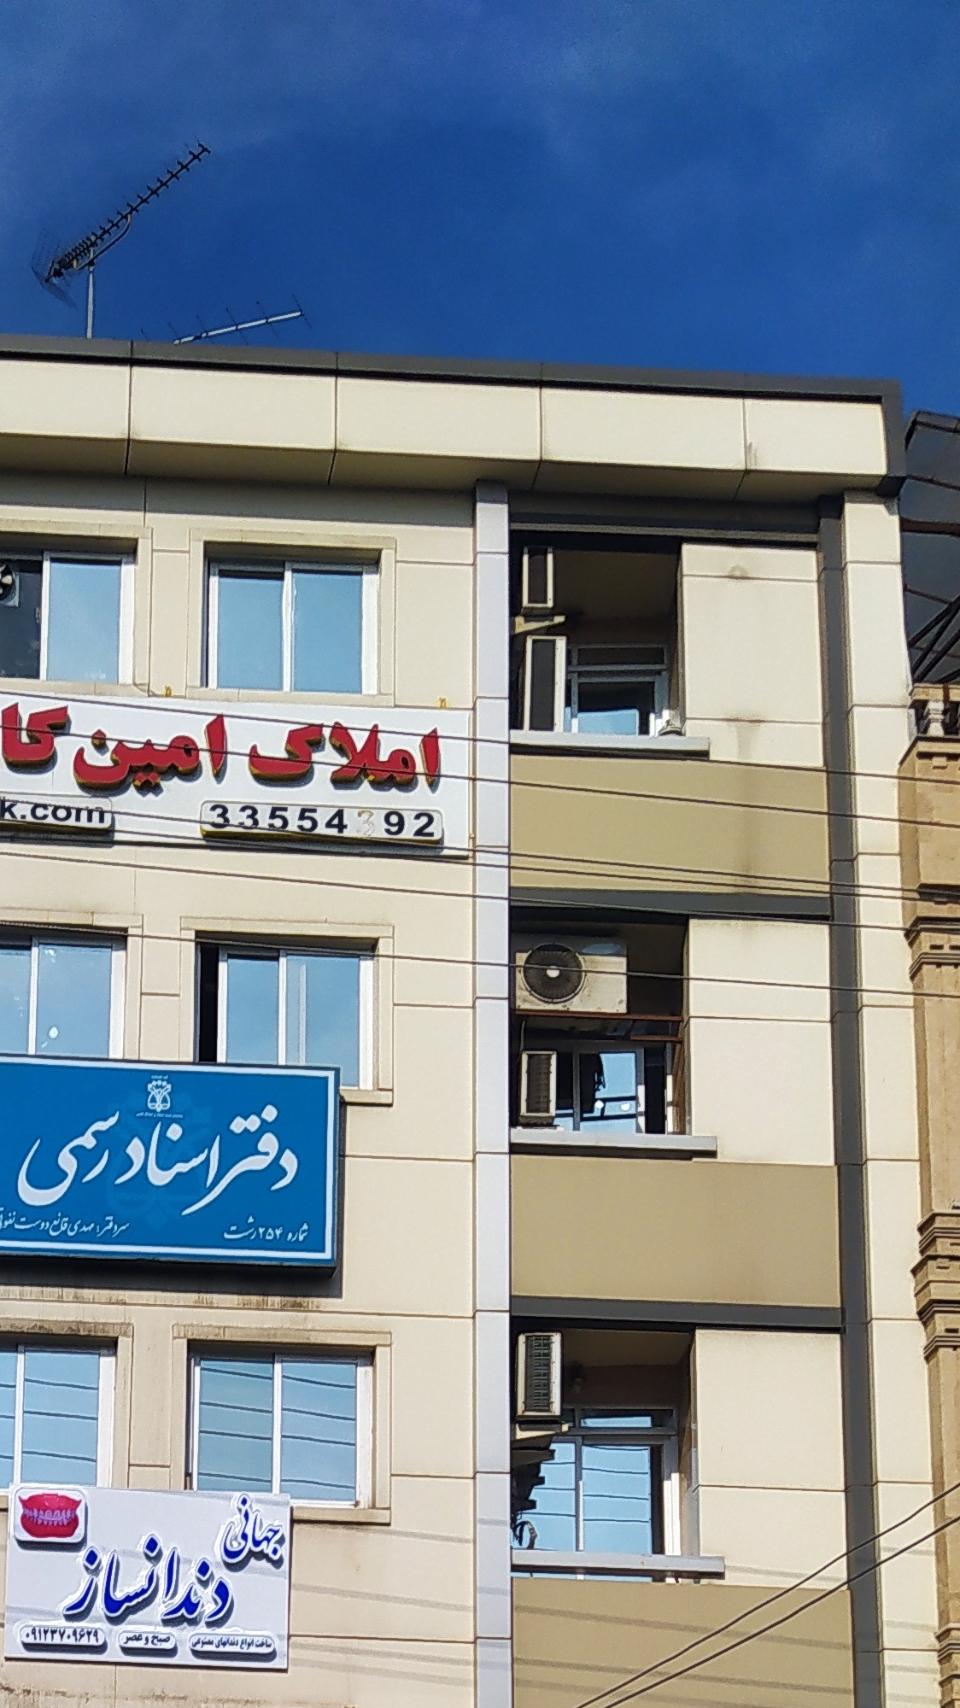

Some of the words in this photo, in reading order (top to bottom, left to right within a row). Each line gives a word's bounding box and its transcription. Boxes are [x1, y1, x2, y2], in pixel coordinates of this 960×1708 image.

[73, 713, 226, 789] امین
[249, 721, 440, 786] املاک
[208, 803, 435, 838] 33554392
[17, 1110, 120, 1207] رسمی
[114, 1120, 221, 1188] اسناد
[182, 1104, 298, 1216] دفتر
[67, 1219, 95, 1237] مهدی
[223, 1215, 257, 1240] رشت
[258, 1226, 284, 1240] ۲۵۴
[286, 1222, 309, 1242] شماره
[222, 1494, 283, 1562] جهانی
[63, 1534, 231, 1622] دندانساز
[123, 1633, 143, 1645] عصر
[150, 1634, 171, 1647] صبح
